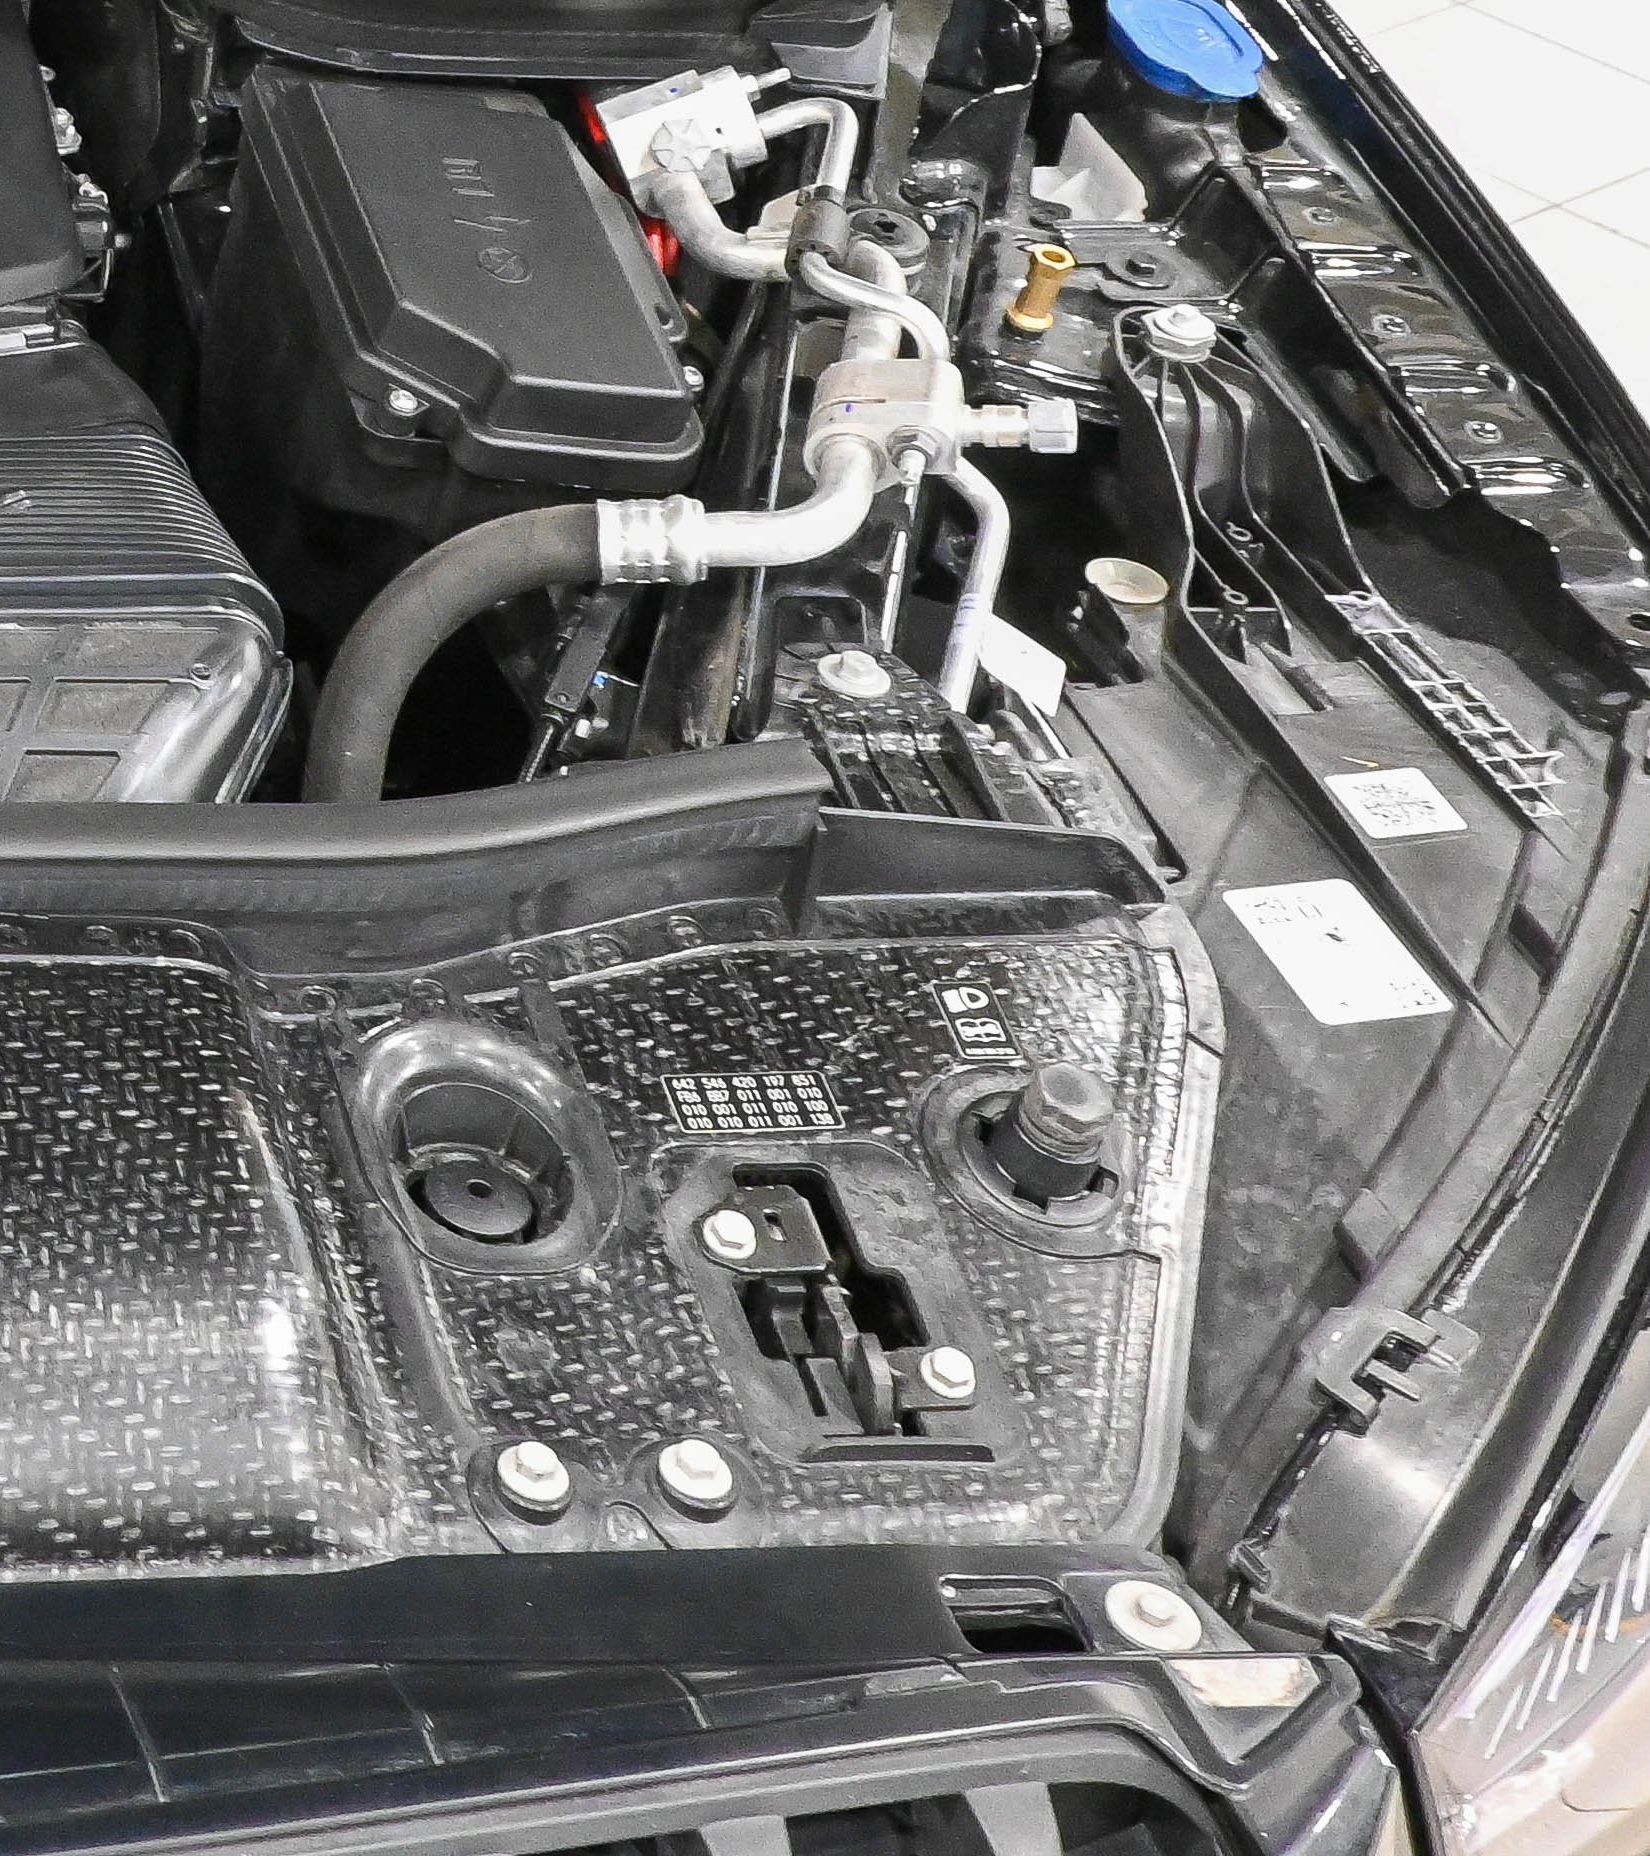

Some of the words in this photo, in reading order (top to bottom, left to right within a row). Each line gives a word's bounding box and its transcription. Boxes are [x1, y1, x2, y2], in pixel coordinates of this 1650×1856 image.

[672, 1078, 697, 1089] 642
[762, 1075, 784, 1086] 197
[737, 1089, 762, 1101] 011
[767, 1089, 792, 1100] 001
[797, 1087, 823, 1099] 010
[681, 1104, 707, 1116] 010
[712, 1104, 737, 1115] 001
[742, 1103, 767, 1114] 011
[772, 1101, 798, 1113] 010
[803, 1100, 828, 1111] 100
[687, 1117, 713, 1129] 010
[717, 1116, 743, 1128] 010
[748, 1116, 773, 1127] 011
[778, 1115, 803, 1126] 001
